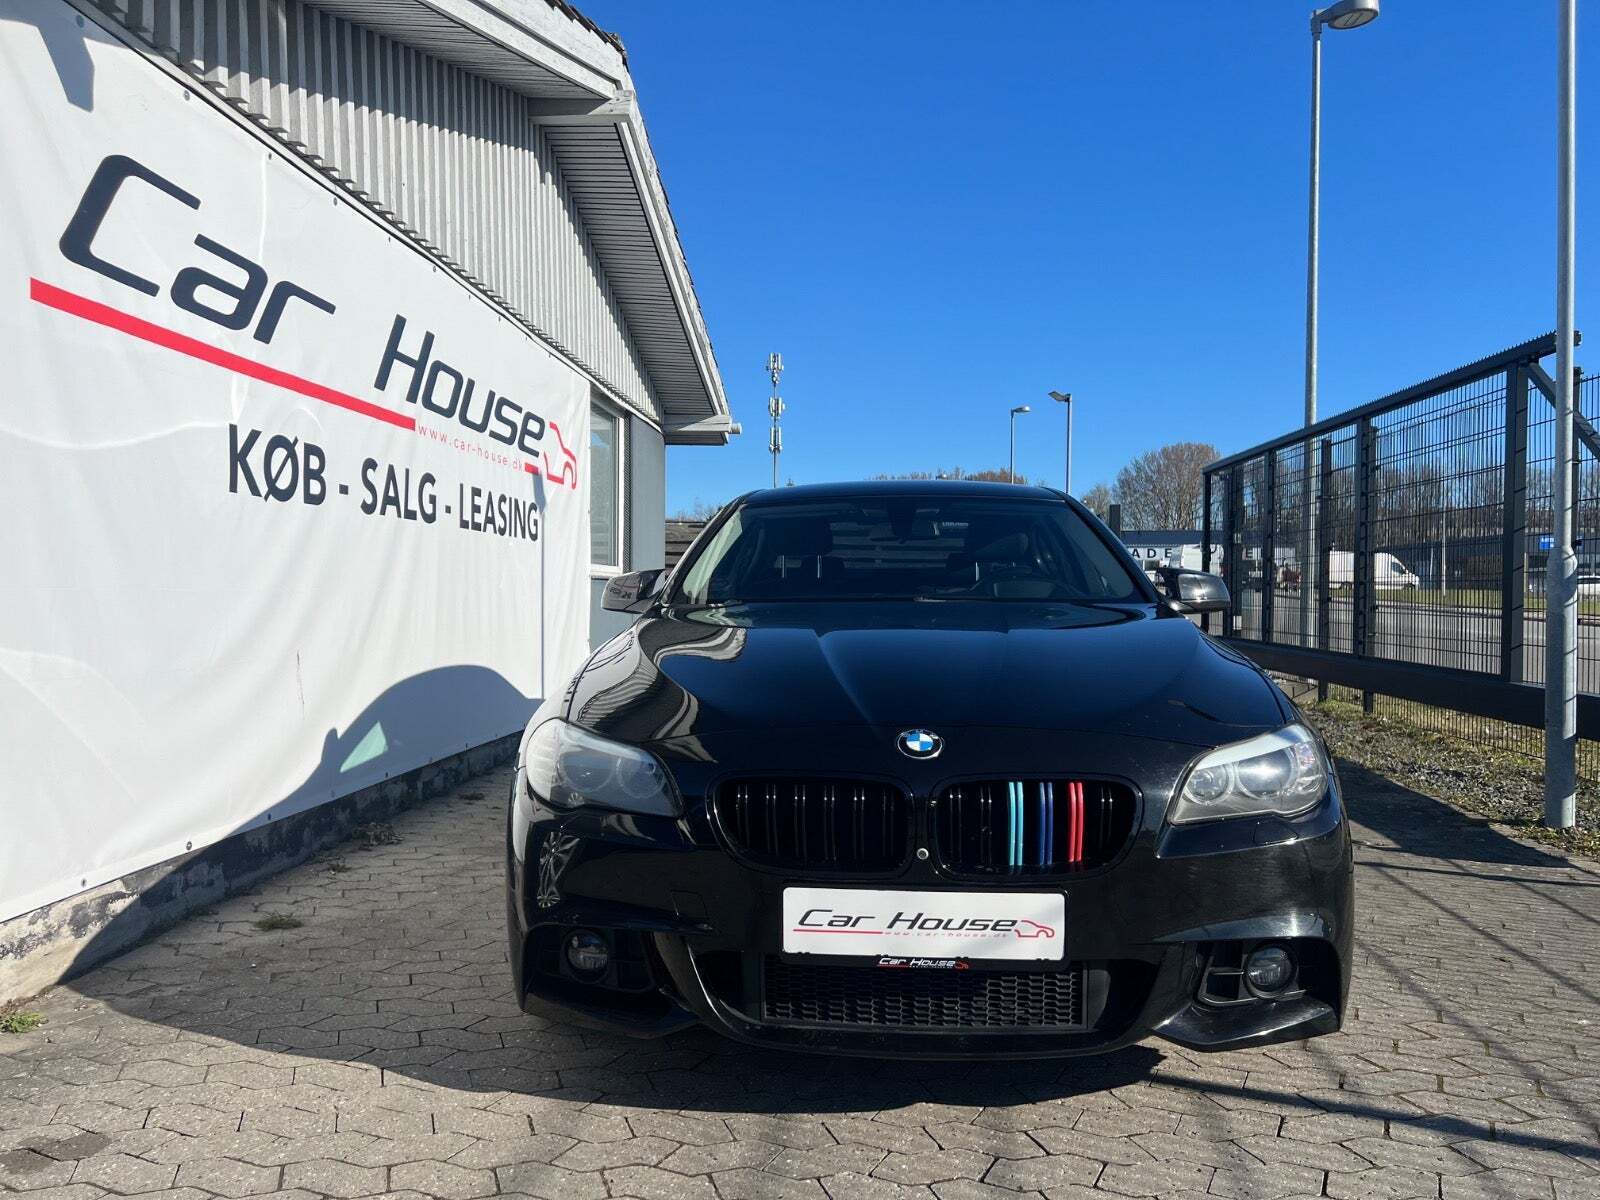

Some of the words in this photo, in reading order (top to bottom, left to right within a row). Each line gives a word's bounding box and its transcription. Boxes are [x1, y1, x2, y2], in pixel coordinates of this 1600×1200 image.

[60, 154, 335, 345] Car
[375, 315, 546, 458] House
[229, 424, 327, 506] KØB
[361, 457, 437, 525] SALG
[459, 483, 539, 542] LEASING
[798, 908, 875, 928] Car
[886, 911, 1018, 932] House
[879, 957, 906, 965] Car
[909, 958, 956, 967] House
